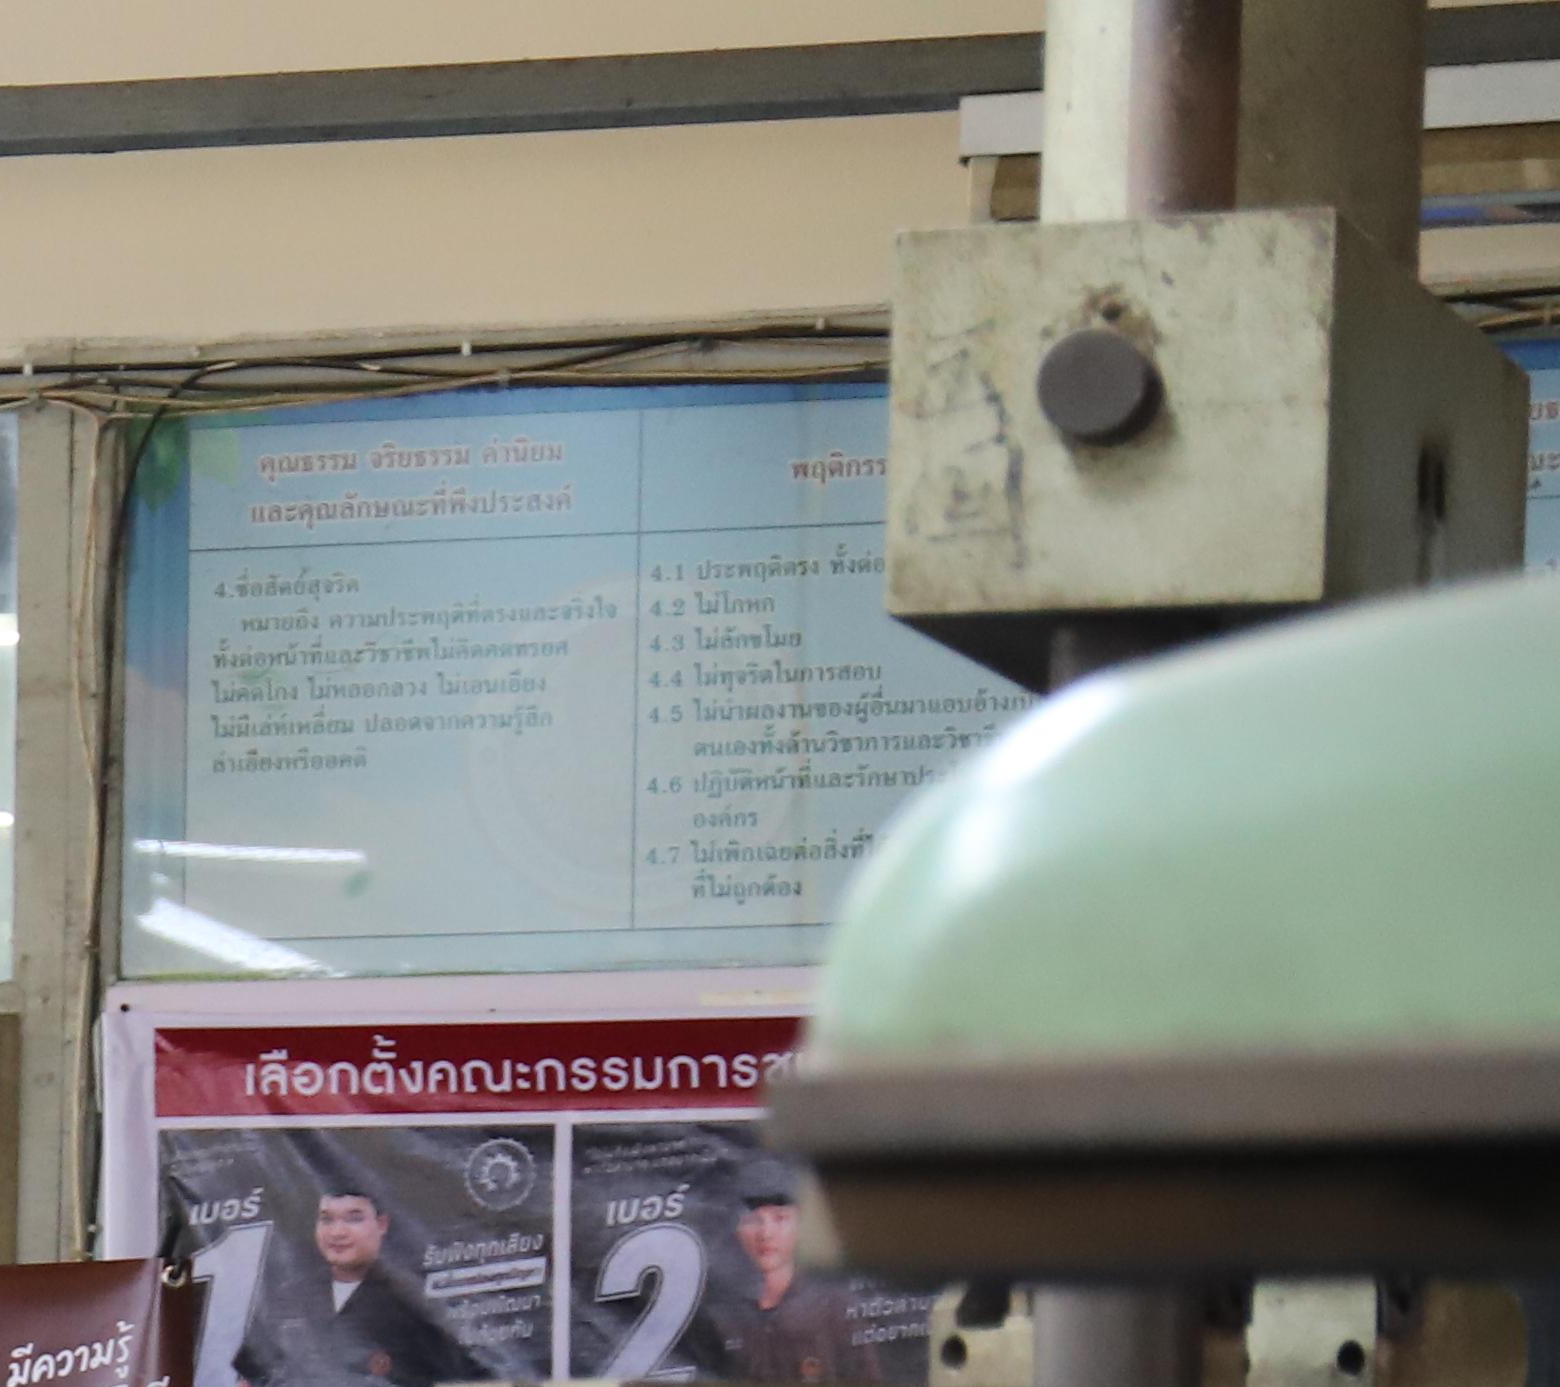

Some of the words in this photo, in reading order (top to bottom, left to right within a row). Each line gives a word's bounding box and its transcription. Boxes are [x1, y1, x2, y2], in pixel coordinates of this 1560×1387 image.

[792, 451, 888, 484] พฤติกรร
[829, 544, 887, 575] ทั้งต่อ
[606, 1184, 691, 1227] เบอร์
[596, 1222, 708, 1381] 2
